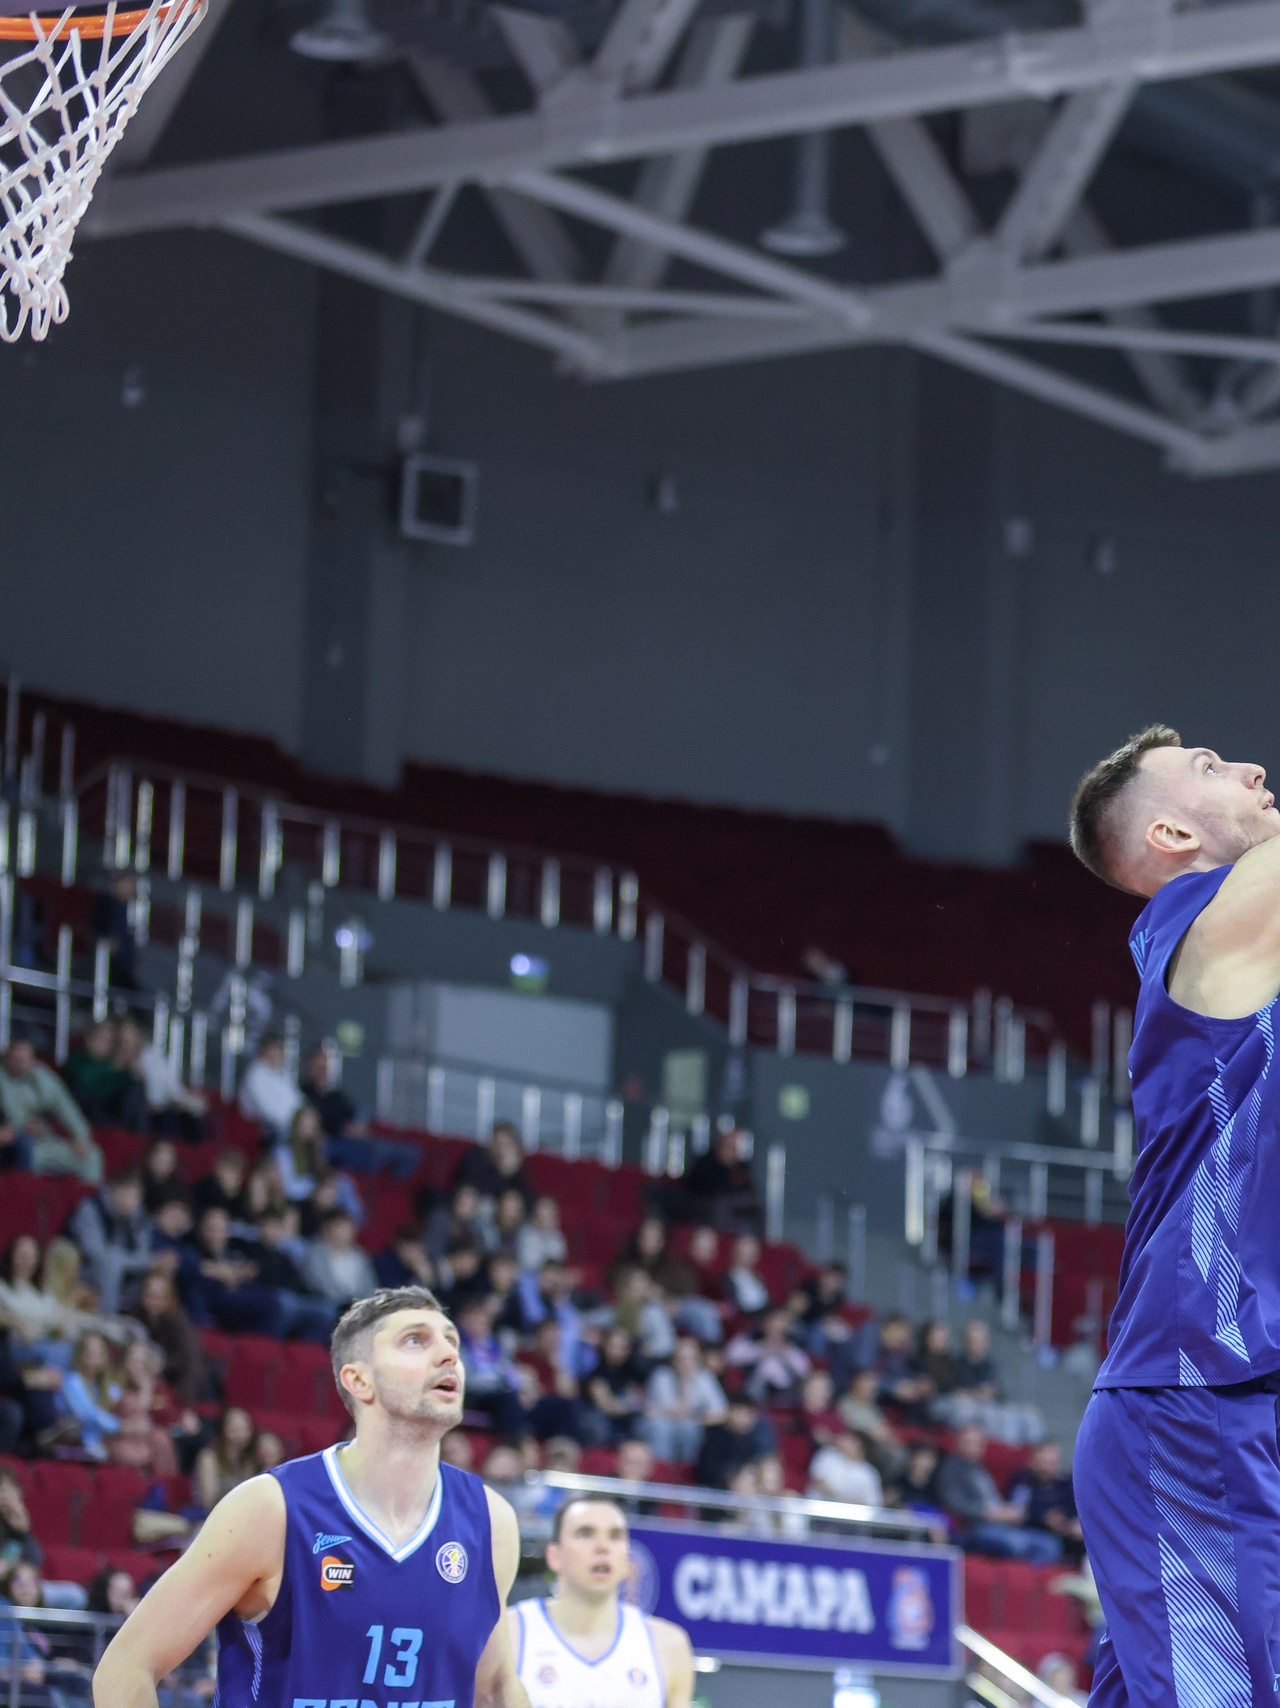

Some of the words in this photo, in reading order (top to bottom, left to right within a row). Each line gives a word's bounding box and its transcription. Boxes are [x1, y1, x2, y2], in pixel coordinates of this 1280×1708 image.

[328, 1567, 353, 1580] WIN
[672, 1551, 876, 1635] САМАРА
[362, 1624, 424, 1688] 13
